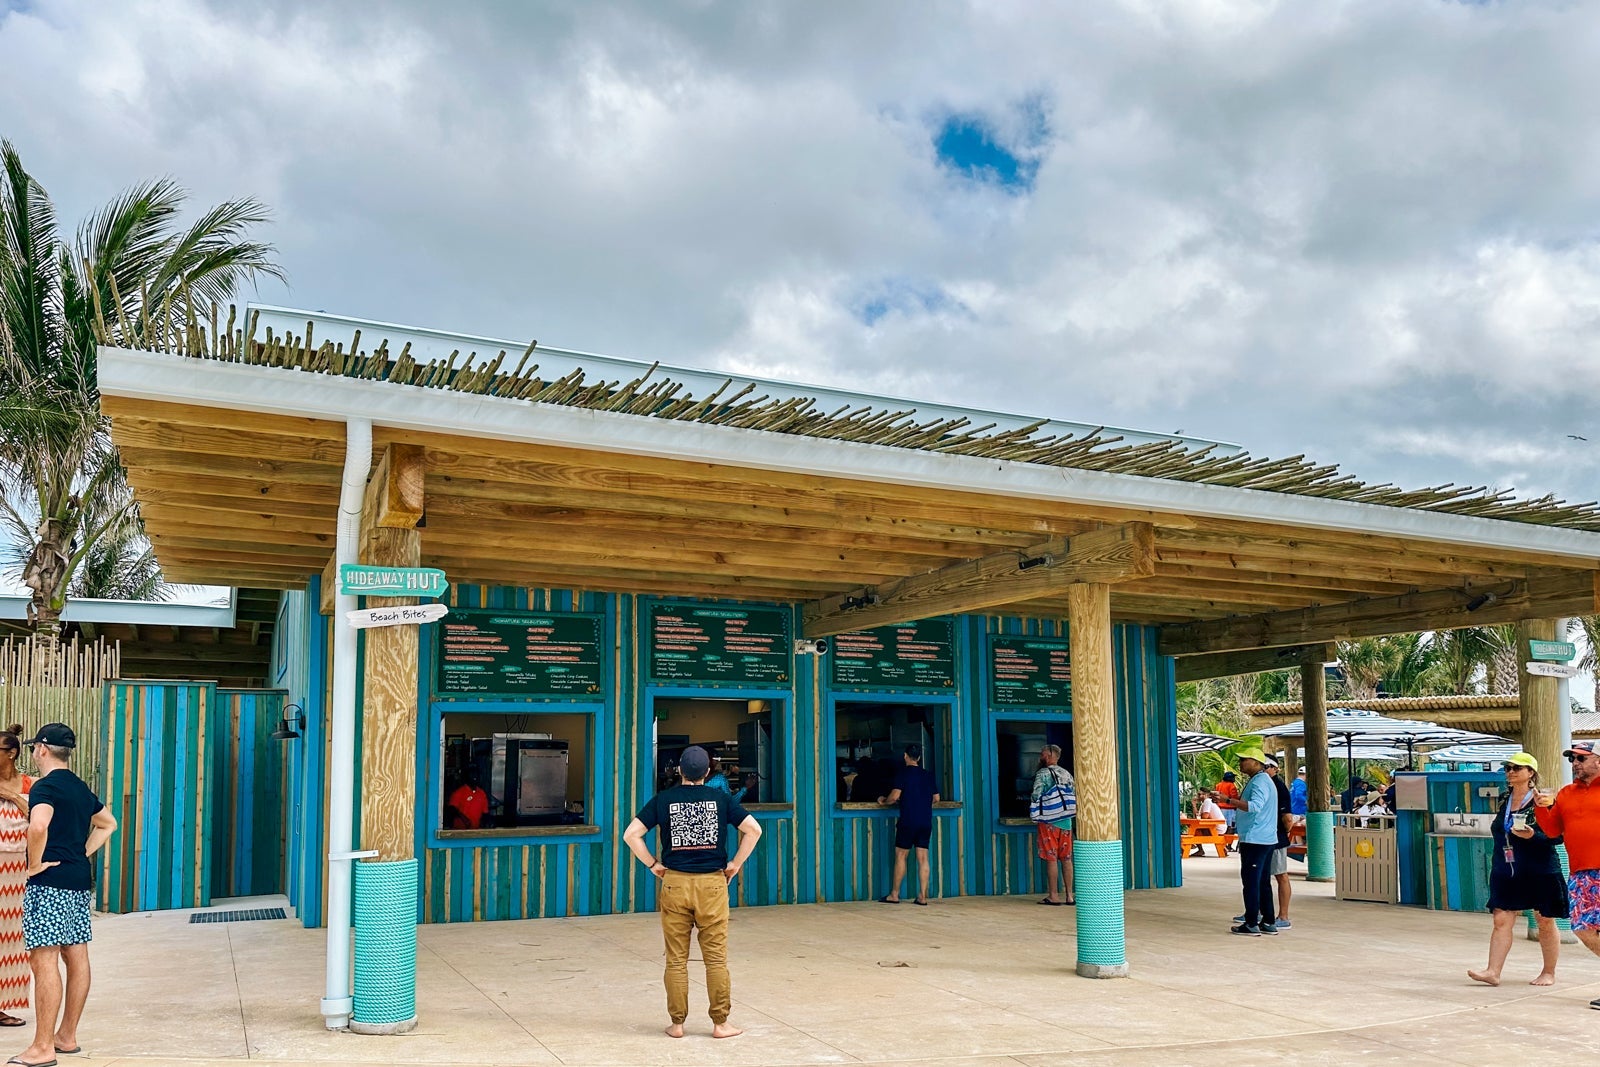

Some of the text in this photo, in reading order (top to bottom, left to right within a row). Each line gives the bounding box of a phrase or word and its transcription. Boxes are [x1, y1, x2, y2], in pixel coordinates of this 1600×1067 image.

[346, 571, 441, 590] HIDEAWAY HUT
[370, 609, 427, 622] Beach Bites
[1558, 645, 1573, 655] HUT
